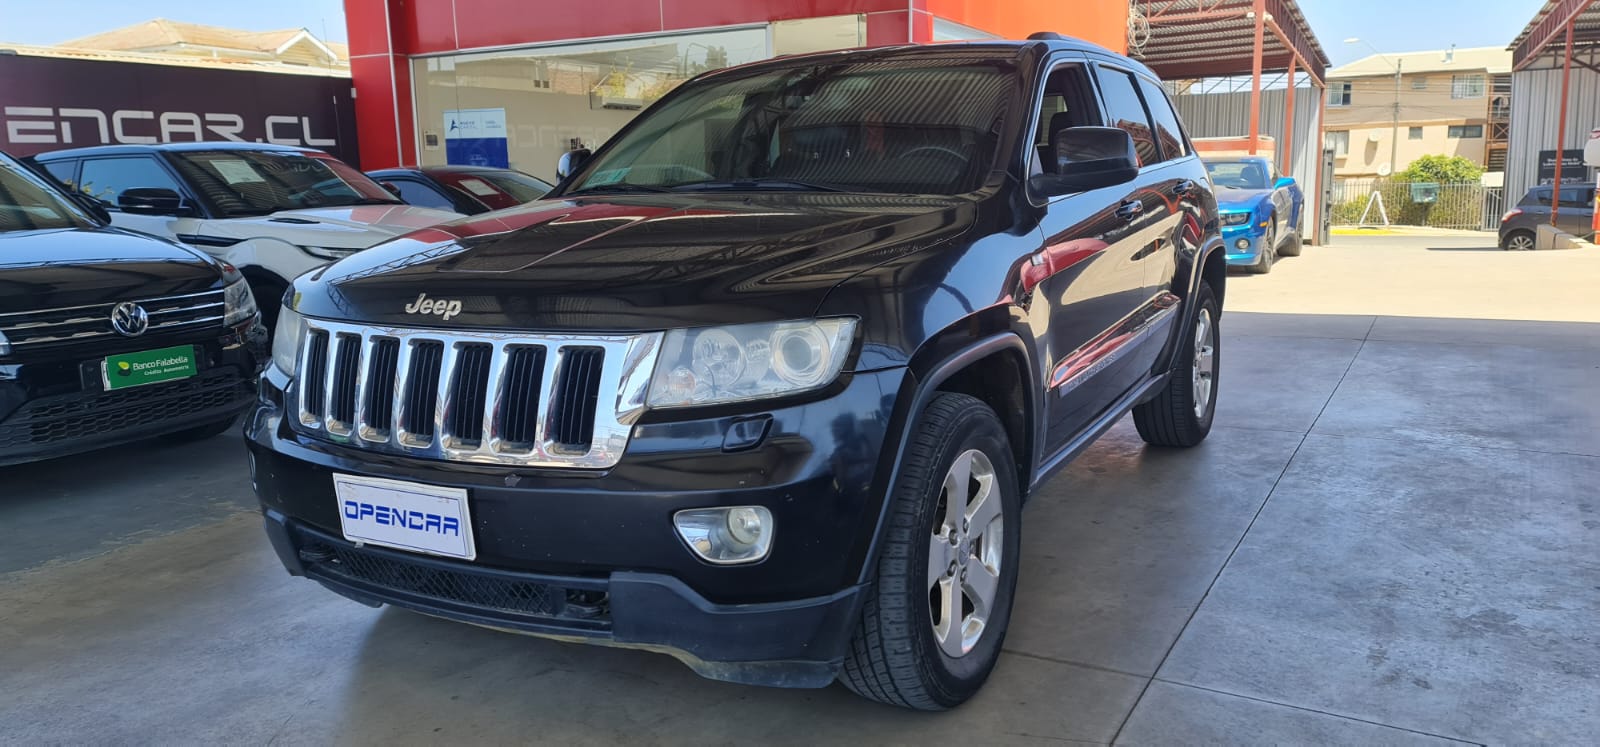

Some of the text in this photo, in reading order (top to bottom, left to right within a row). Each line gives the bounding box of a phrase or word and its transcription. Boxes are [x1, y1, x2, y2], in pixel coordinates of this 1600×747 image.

[405, 292, 462, 321] Jeep
[132, 356, 188, 371] Banco Falabella
[344, 500, 460, 537] OPENCAR
